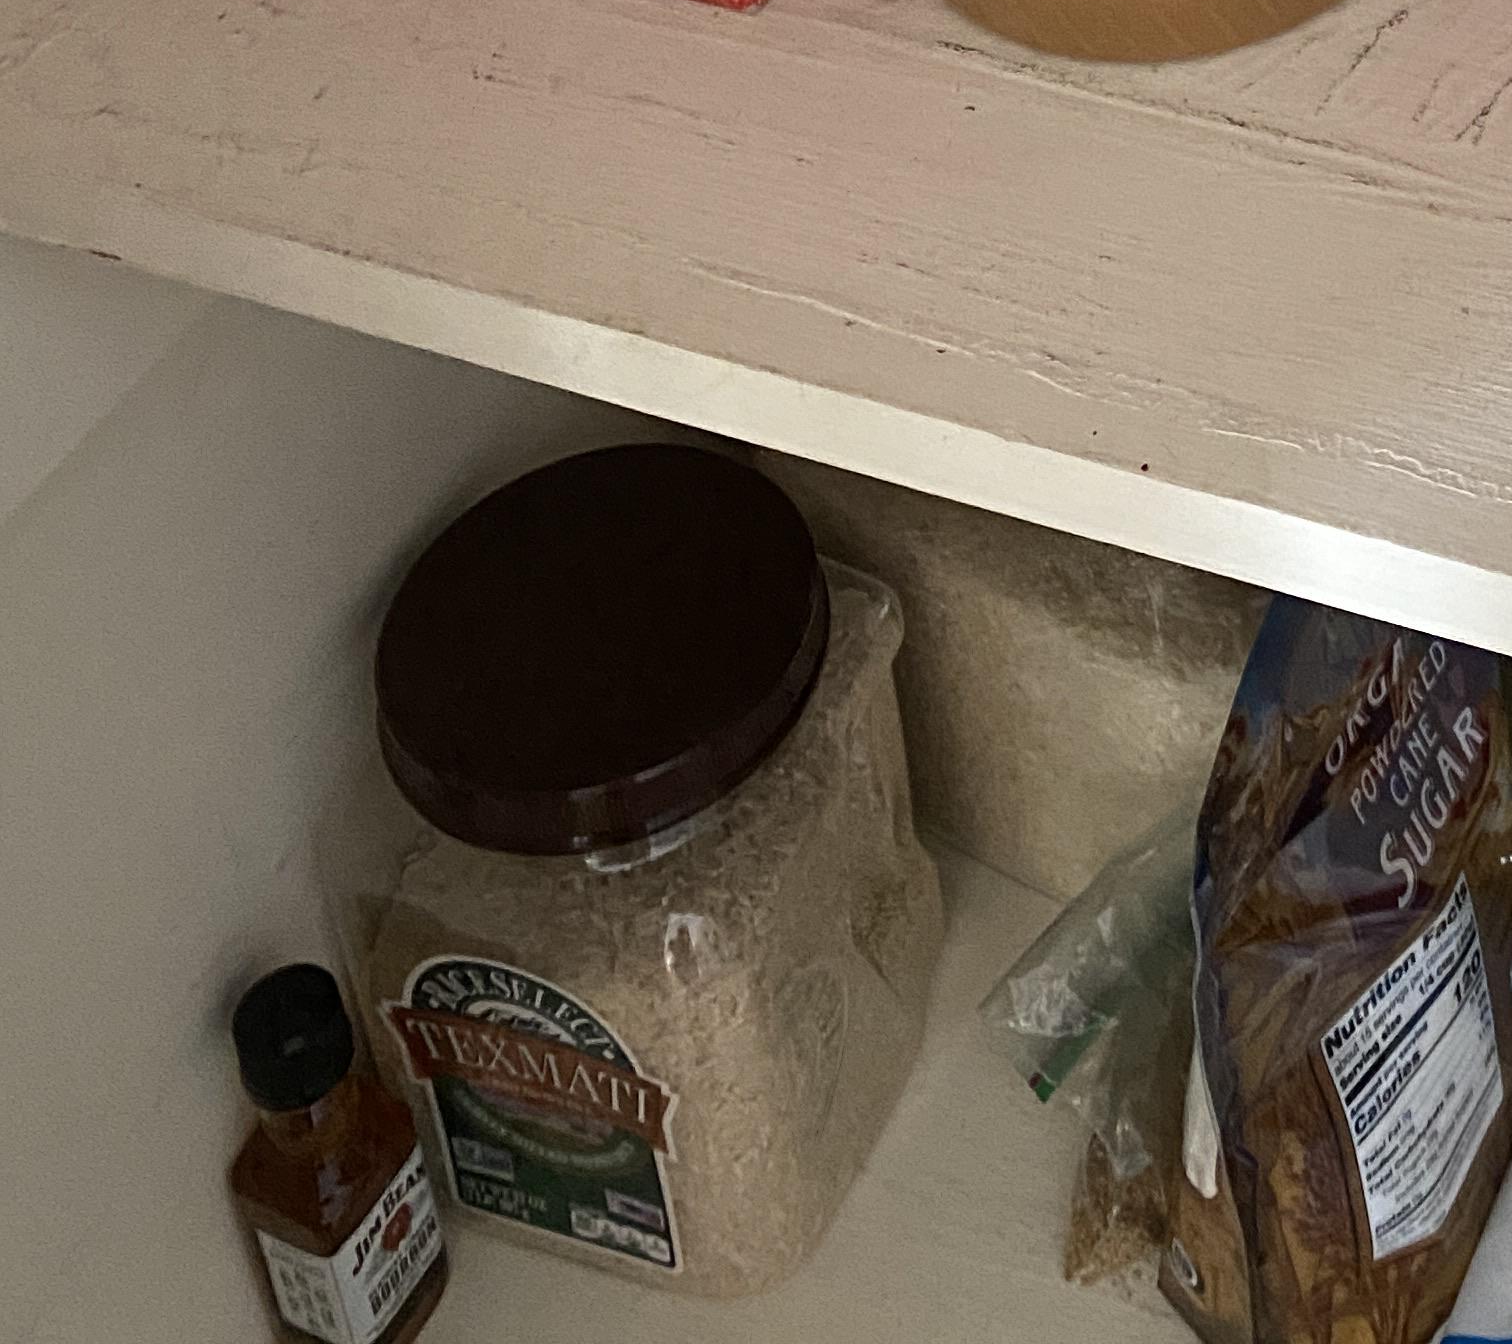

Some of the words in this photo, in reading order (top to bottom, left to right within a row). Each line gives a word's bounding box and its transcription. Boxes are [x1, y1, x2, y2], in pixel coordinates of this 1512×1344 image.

[1351, 641, 1446, 825] POWDERED
[1390, 713, 1439, 806] CANE
[1380, 706, 1487, 909] SUGAR
[1324, 952, 1416, 1060] Nutrition
[1421, 880, 1469, 956] Facts
[1453, 950, 1482, 1004] 120
[406, 1019, 647, 1125] TEXMATI
[1353, 1053, 1422, 1136] Calories
[353, 1216, 382, 1277] JIM
